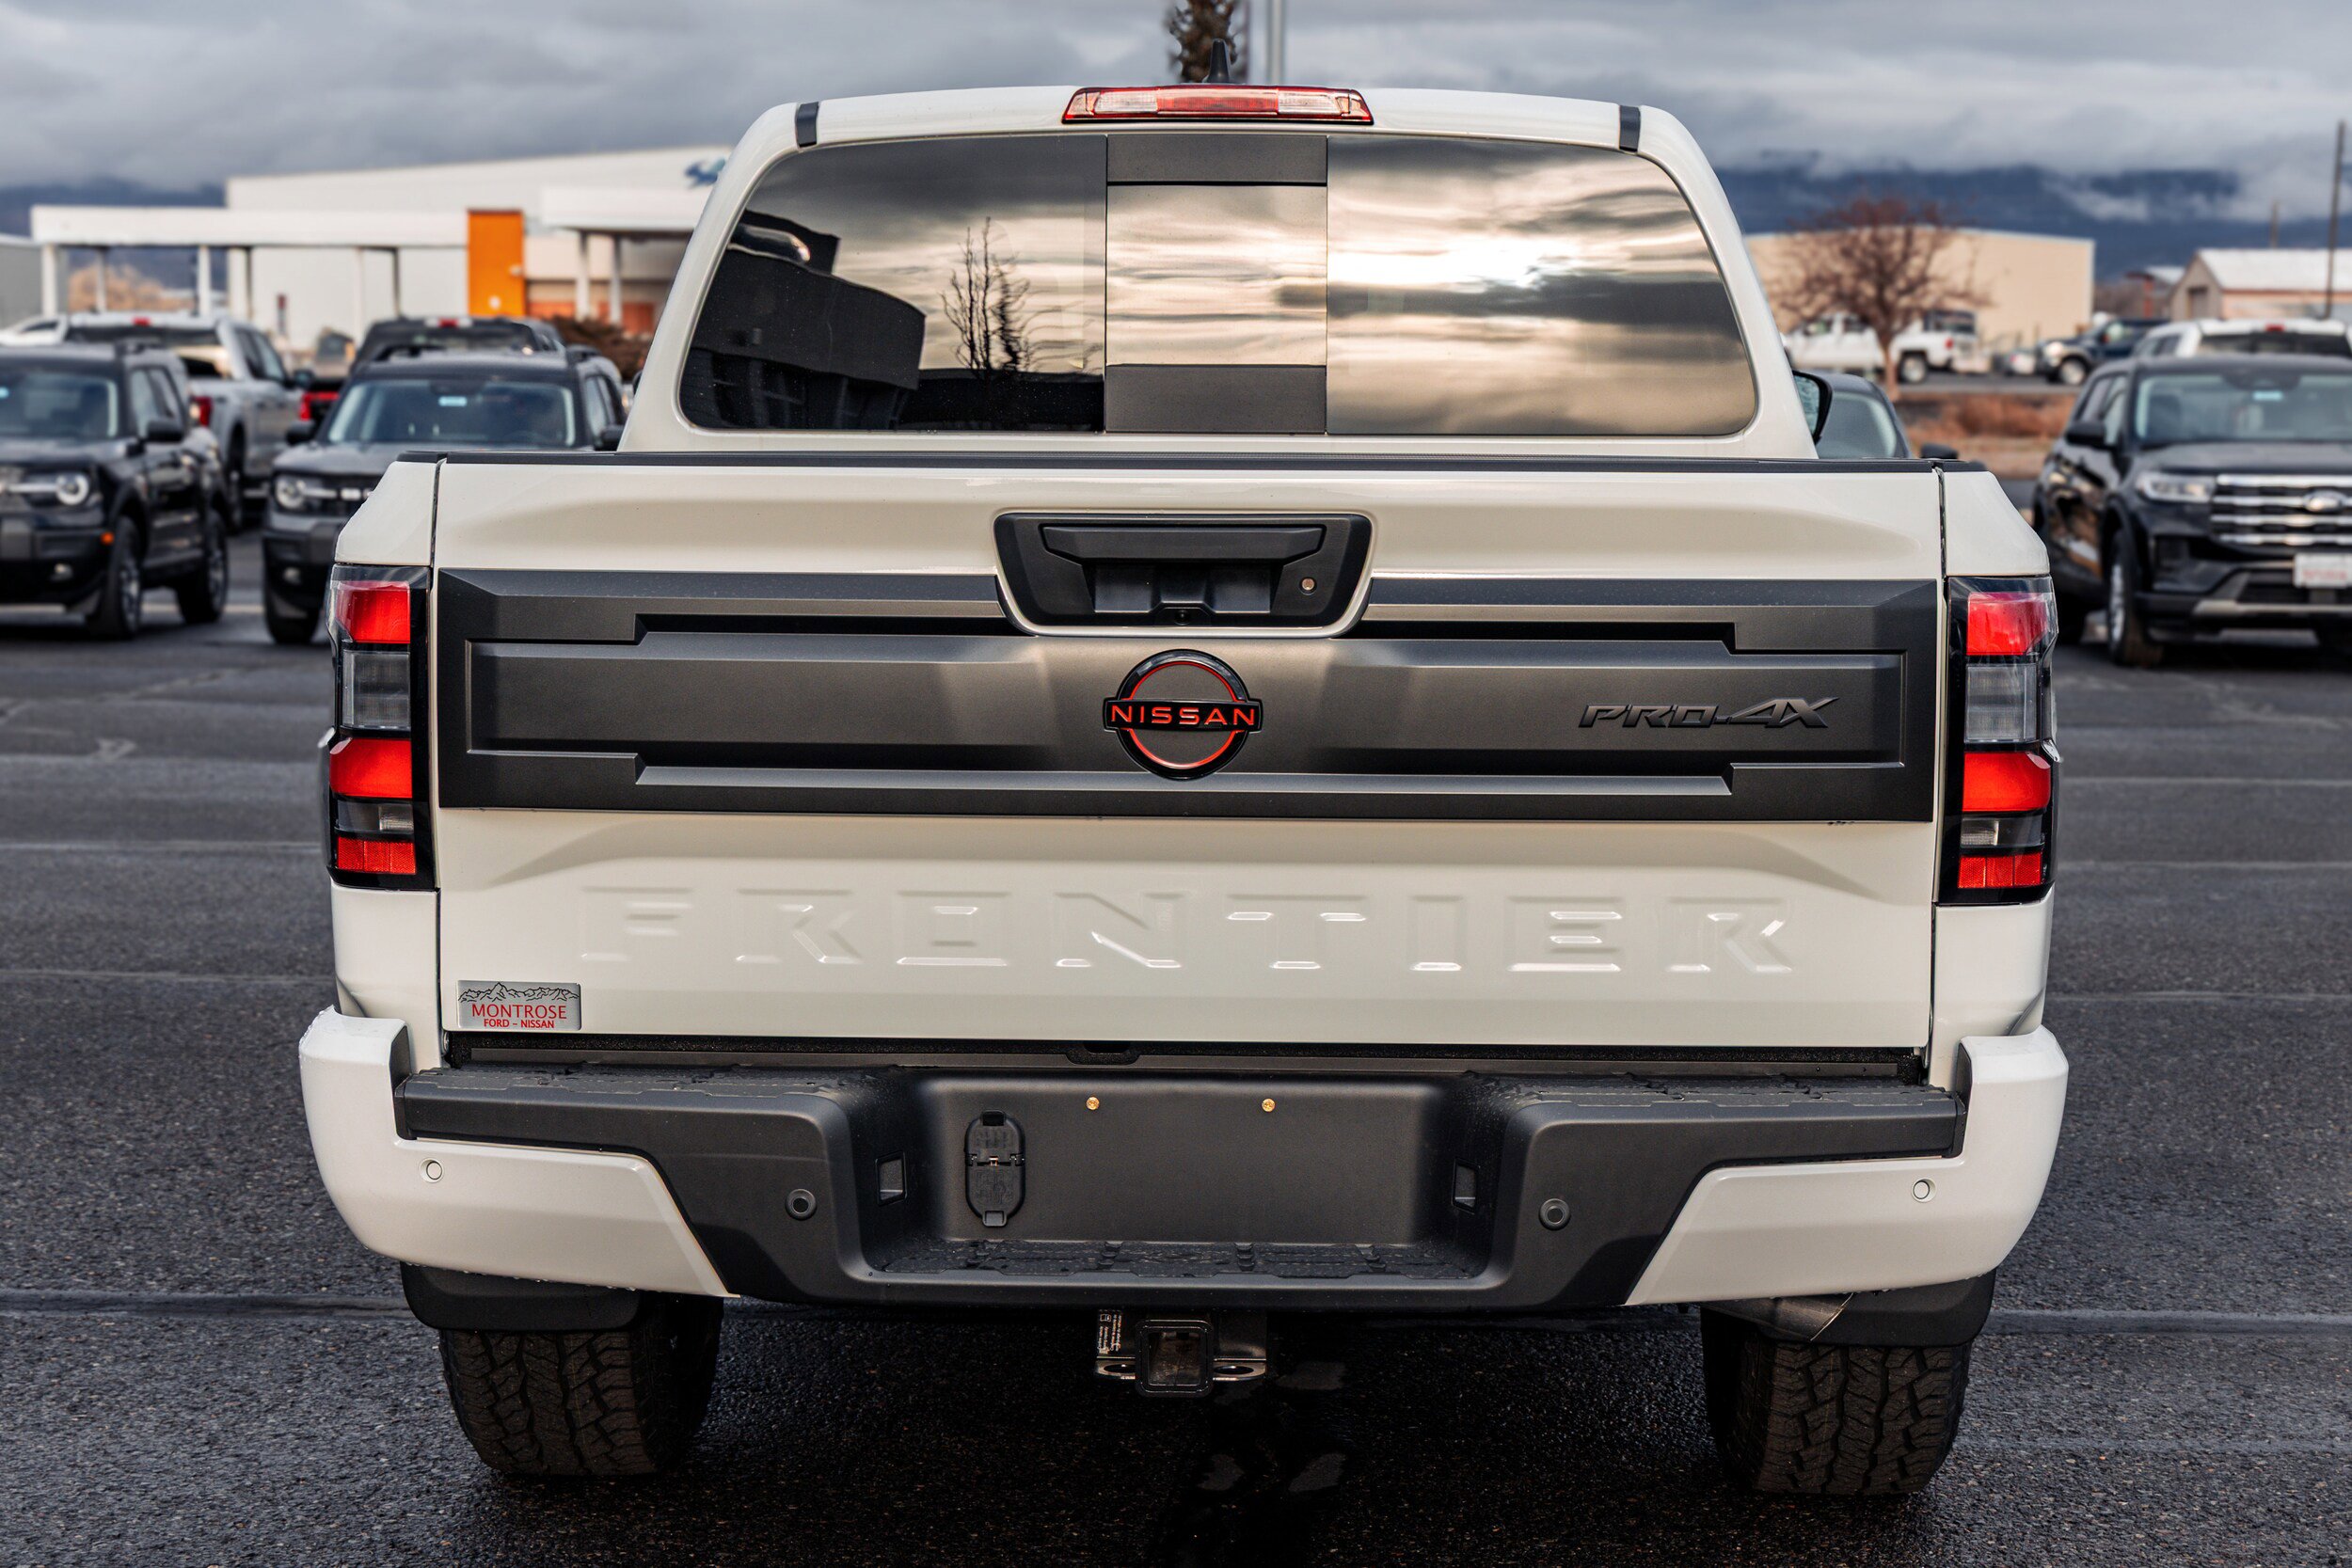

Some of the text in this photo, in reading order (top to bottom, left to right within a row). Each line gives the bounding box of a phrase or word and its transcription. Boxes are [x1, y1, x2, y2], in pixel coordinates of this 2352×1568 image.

[1111, 705, 1254, 726] NISSAN
[1578, 696, 1840, 729] PRO-4X
[580, 887, 1793, 974] FRONTIER
[471, 1004, 567, 1020] MONTROSE
[484, 1018, 510, 1028] FORD
[520, 1020, 555, 1029] NISSAN
